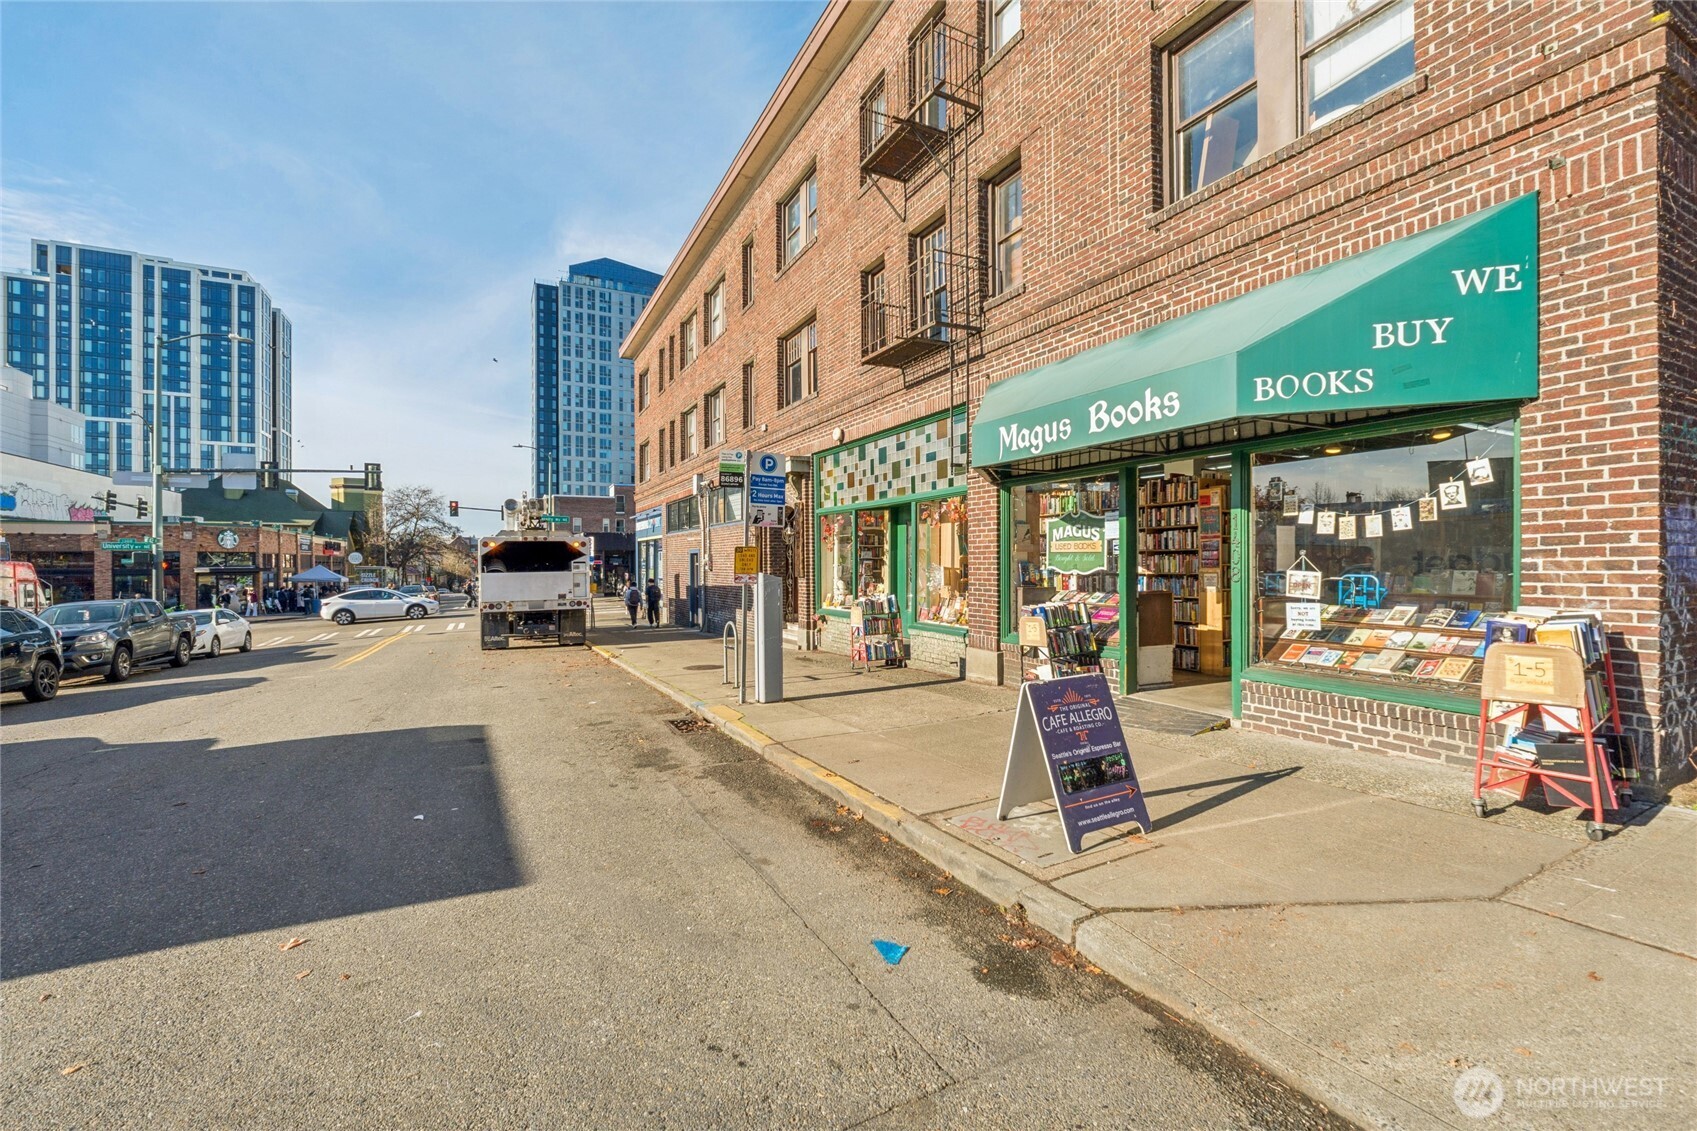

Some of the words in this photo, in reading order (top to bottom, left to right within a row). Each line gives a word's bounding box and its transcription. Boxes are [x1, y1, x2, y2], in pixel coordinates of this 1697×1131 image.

[1452, 264, 1522, 295] WE
[1372, 316, 1454, 350] BUY
[1253, 367, 1374, 402] BOOKS
[999, 413, 1072, 461] Magus
[1088, 388, 1180, 434] Books
[720, 475, 743, 483] 86896
[1053, 525, 1100, 542] MAGUS
[1055, 542, 1071, 550] USED
[1074, 542, 1096, 550] BOOKS
[1042, 714, 1068, 732] CAFE
[1069, 707, 1112, 724] ALLEGRO
[1073, 723, 1095, 731] ROASTING
[1052, 751, 1072, 760] Seattle's
[1072, 746, 1091, 756] Original
[1091, 743, 1113, 752] Espresso
[1077, 807, 1135, 826] www.seattleallegro.com
